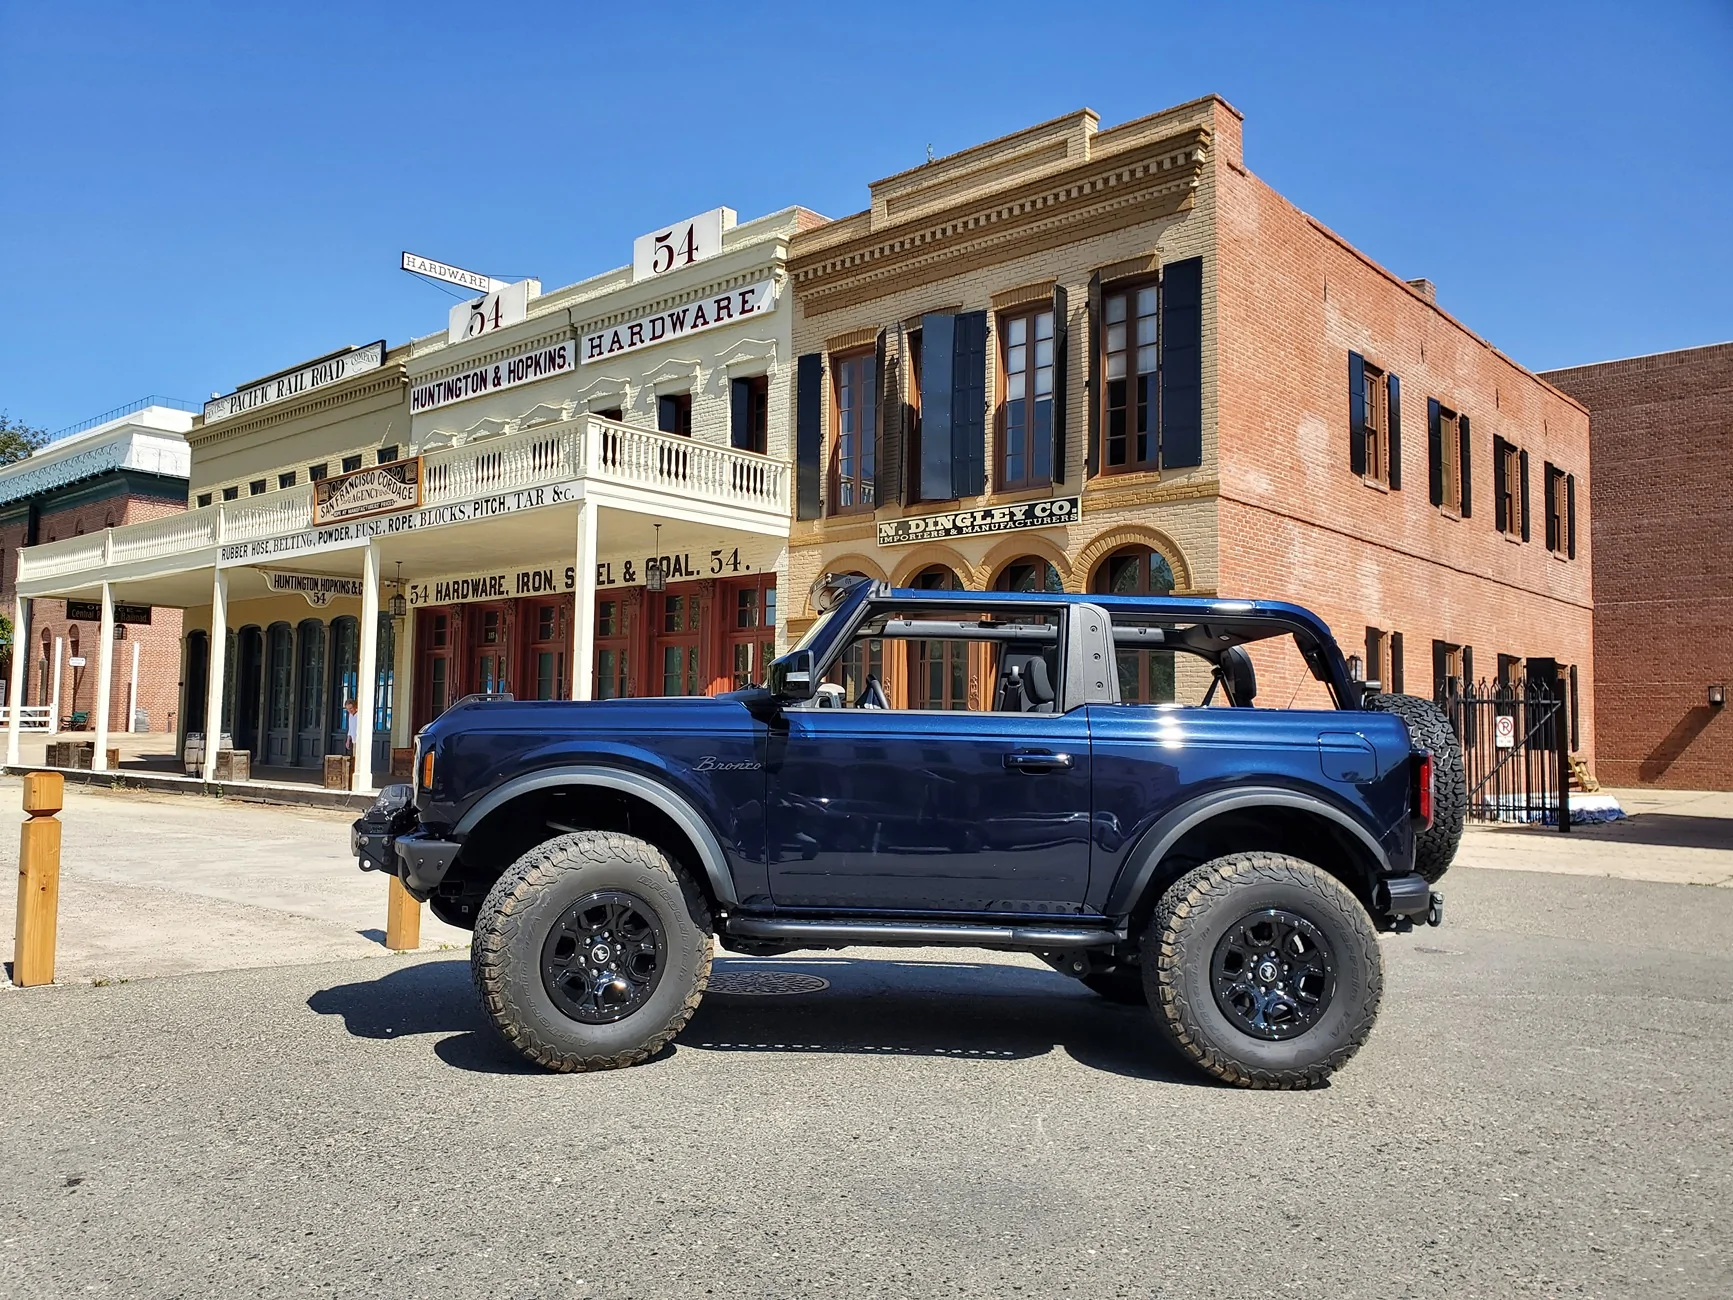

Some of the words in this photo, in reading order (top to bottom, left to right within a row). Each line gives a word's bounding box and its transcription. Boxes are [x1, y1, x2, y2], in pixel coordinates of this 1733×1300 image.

[652, 223, 699, 274] 54
[468, 295, 503, 337] 54
[587, 288, 761, 360] HARDWARE.
[229, 384, 272, 414] PACIFIC
[276, 373, 308, 398] RAIL
[310, 358, 345, 387] ROAD
[350, 350, 379, 367] COMPANY
[412, 368, 489, 411] HUNTINGTON
[492, 366, 502, 386] &
[320, 500, 335, 519] SAN
[335, 472, 375, 508] FRANCISCO
[377, 472, 413, 500] CORDAGE
[351, 487, 380, 504] AGENCY
[221, 544, 249, 561] RUBBER
[251, 540, 273, 556] HOSE,
[273, 532, 316, 554] BELTING,
[317, 526, 353, 546] POWDER,
[355, 519, 386, 538] FUSE,
[514, 488, 545, 510] TAR
[879, 523, 903, 538] N.
[908, 505, 1029, 534] DINGLEY
[1034, 500, 1078, 518] CO.
[879, 530, 946, 545] IMPORTERS
[949, 528, 958, 536] &
[962, 513, 1078, 534] MANUFACTURERS
[320, 578, 351, 595] HOPKINS
[351, 580, 358, 595] &
[410, 584, 430, 605] 54
[435, 574, 510, 603] HARDWARE,
[516, 569, 557, 594] IRON,
[564, 562, 616, 589] SEL
[623, 559, 636, 583] &
[710, 547, 751, 575] 54.
[71, 608, 94, 619] Central
[120, 611, 147, 623] Railroad
[86, 604, 134, 613] OFCE
[313, 591, 327, 605] 54
[692, 755, 762, 772] Bronco
